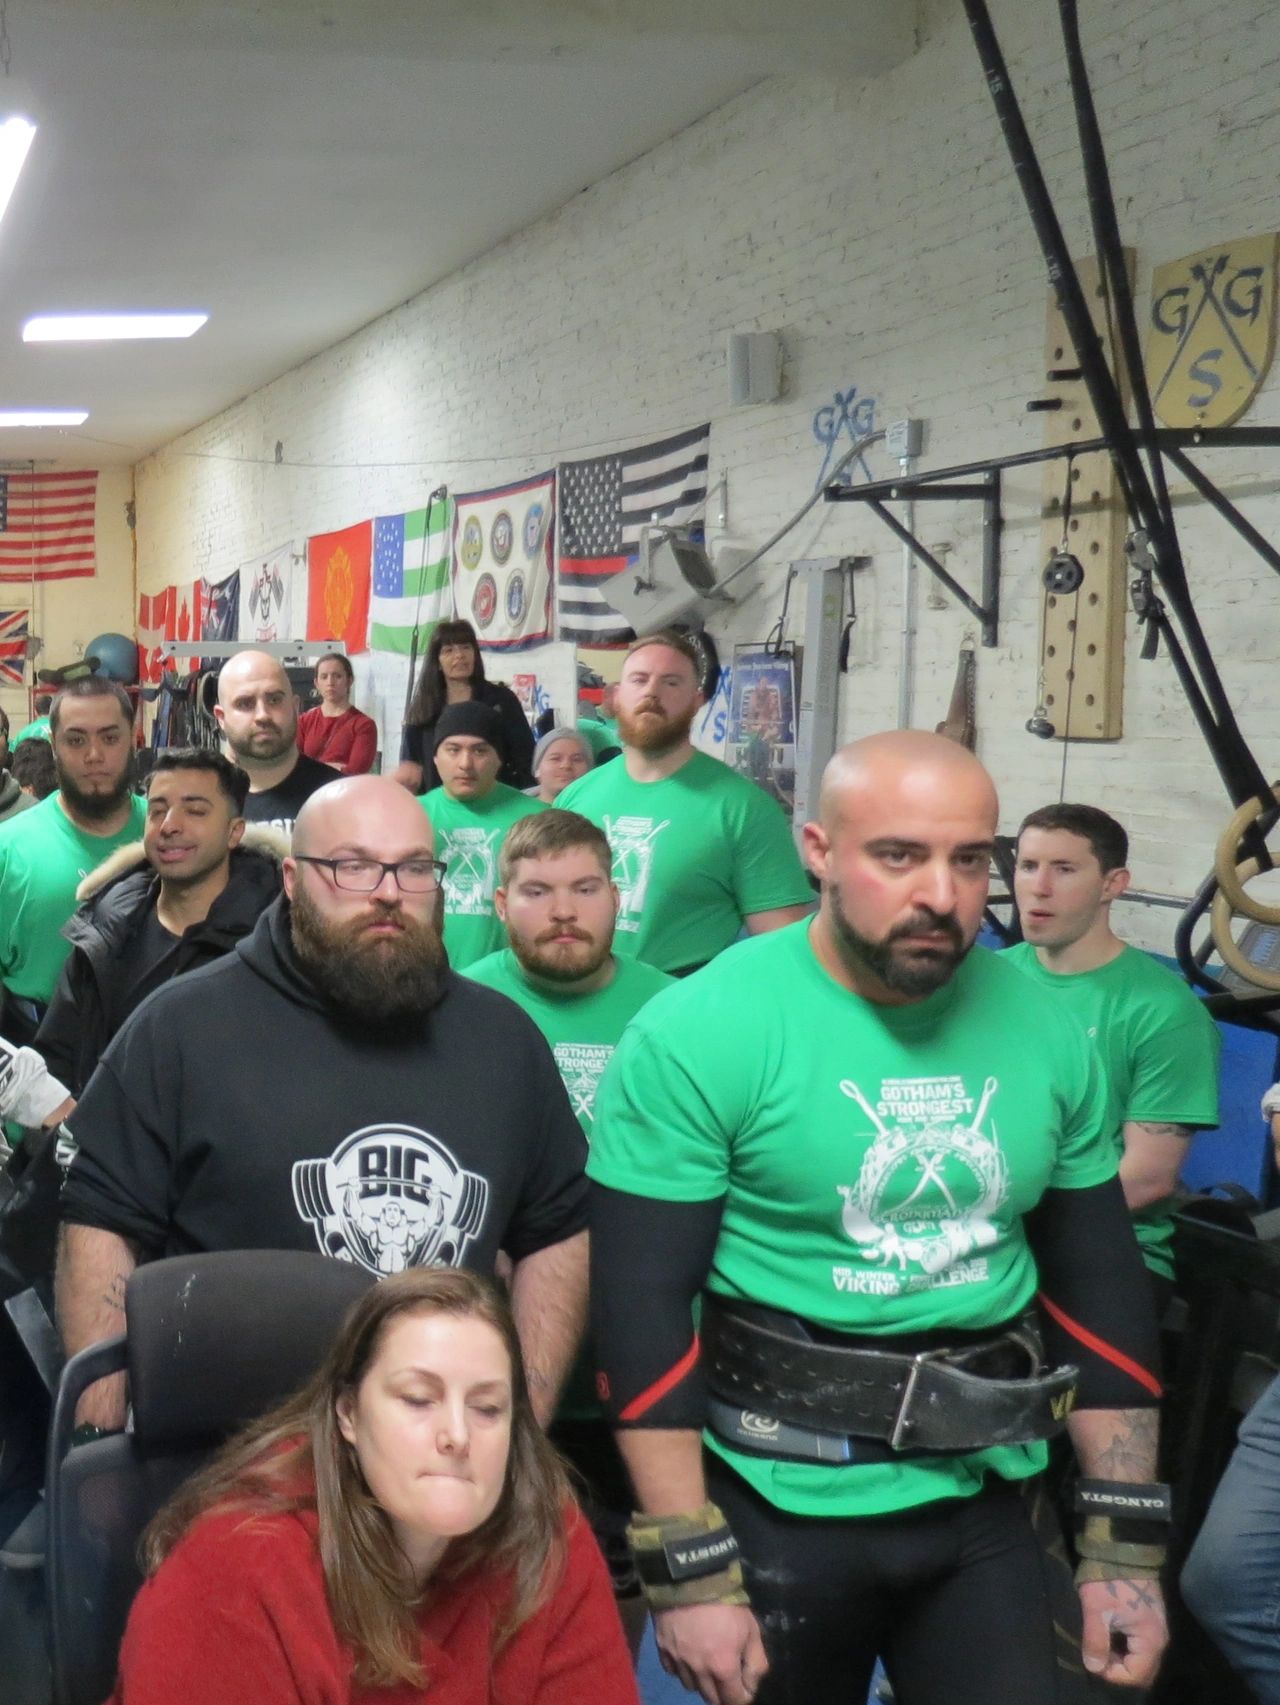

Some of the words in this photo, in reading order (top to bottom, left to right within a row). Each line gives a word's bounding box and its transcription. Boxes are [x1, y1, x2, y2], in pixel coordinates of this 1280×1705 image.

[881, 1083, 965, 1100] GOTHAM'S
[877, 1098, 974, 1117] STRONGEST
[358, 1145, 433, 1206] BIG
[832, 1275, 901, 1296] VIKING
[1080, 1491, 1165, 1508] GANGSTA
